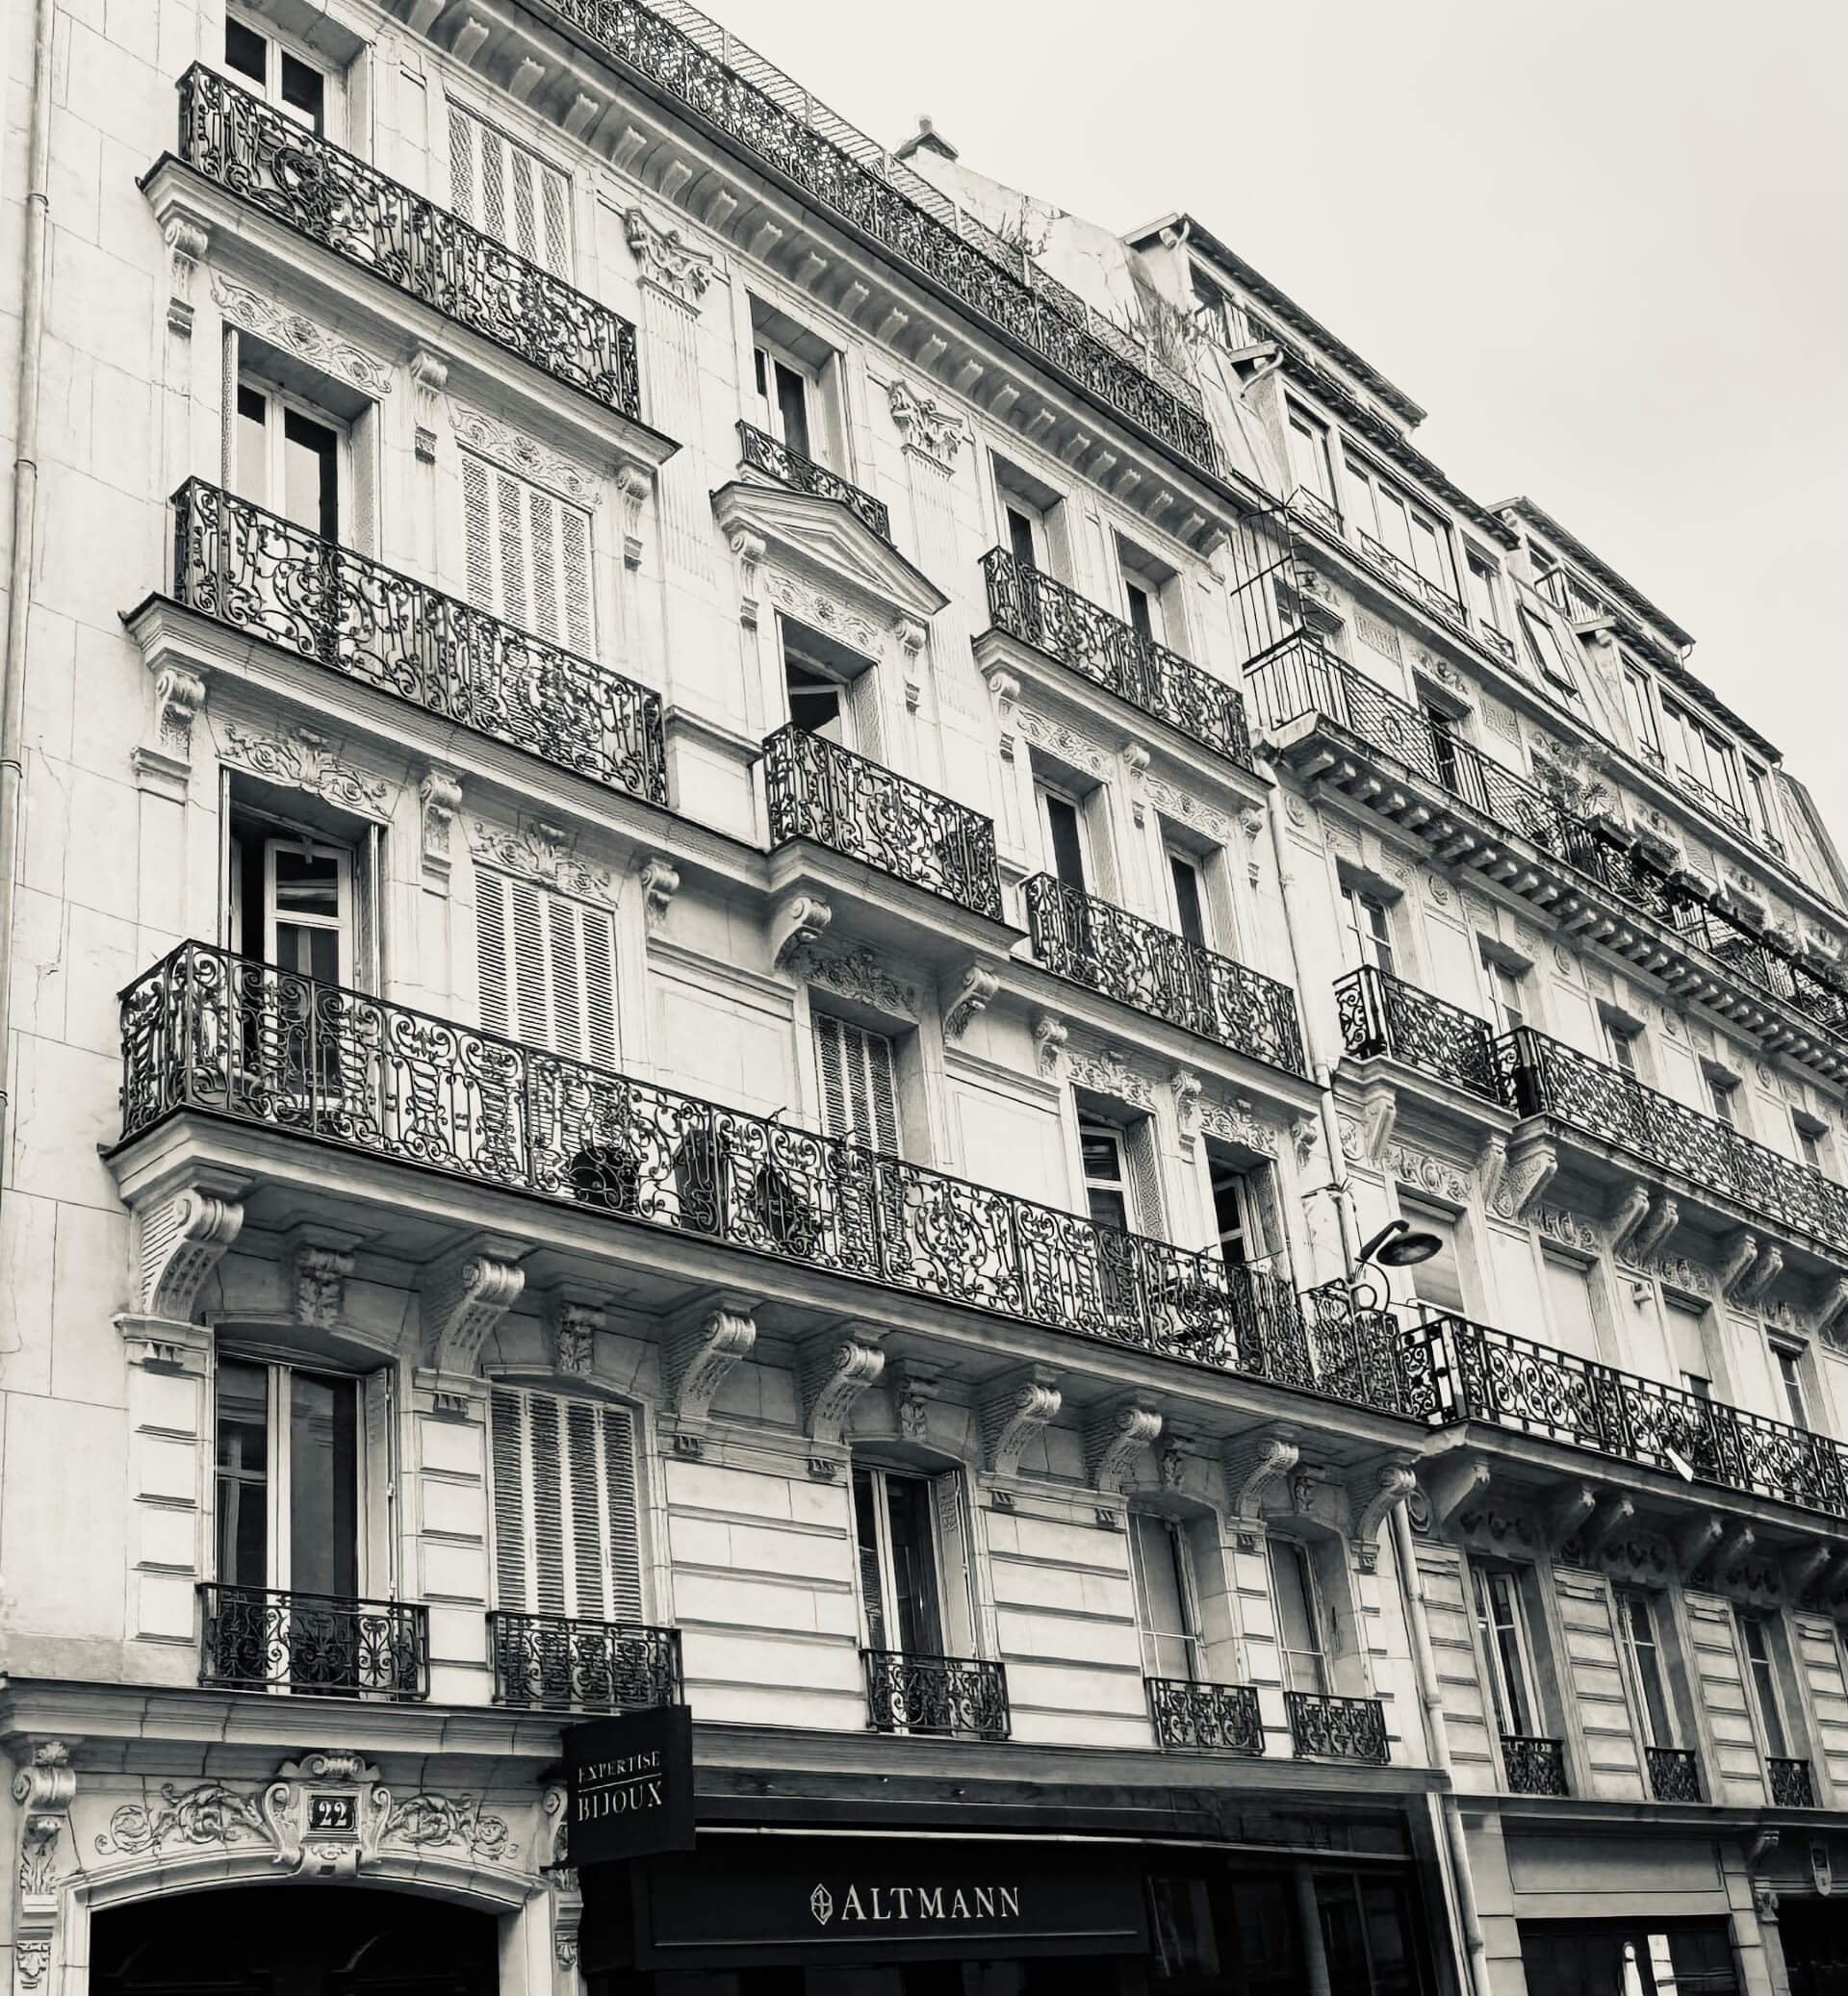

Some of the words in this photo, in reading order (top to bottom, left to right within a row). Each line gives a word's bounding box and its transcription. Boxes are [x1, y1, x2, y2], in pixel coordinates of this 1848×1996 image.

[578, 1751, 660, 1783] EXPERTISE
[319, 1802, 346, 1827] 22
[578, 1780, 662, 1821] BIJOUX
[841, 1883, 1019, 1921] ALTMANN
